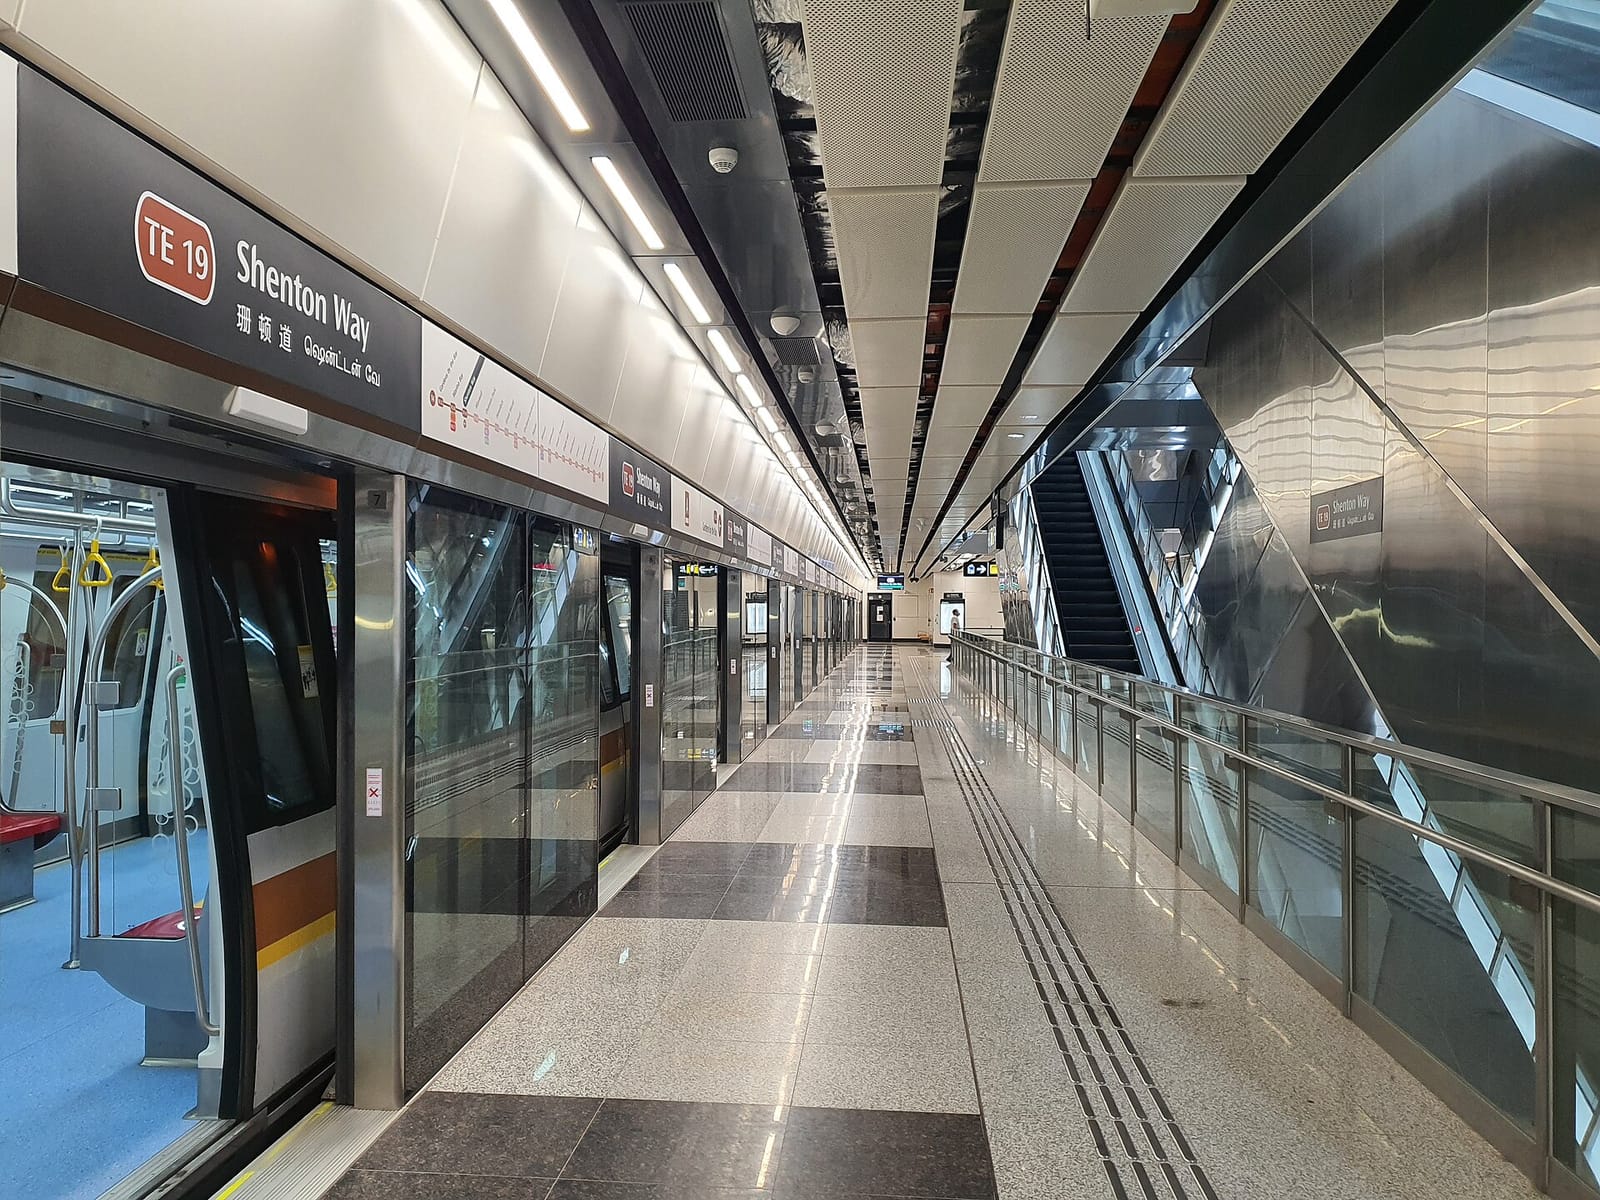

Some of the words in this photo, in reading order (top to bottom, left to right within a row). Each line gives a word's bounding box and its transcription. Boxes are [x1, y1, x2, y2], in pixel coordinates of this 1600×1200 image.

[143, 216, 175, 266] TE
[182, 239, 209, 281] 19
[236, 240, 328, 325] Shenton
[333, 293, 370, 353] Way
[236, 303, 293, 353] 珊顿道
[373, 494, 381, 506] 7
[1333, 499, 1356, 514] Shenton
[1358, 494, 1370, 509] Way
